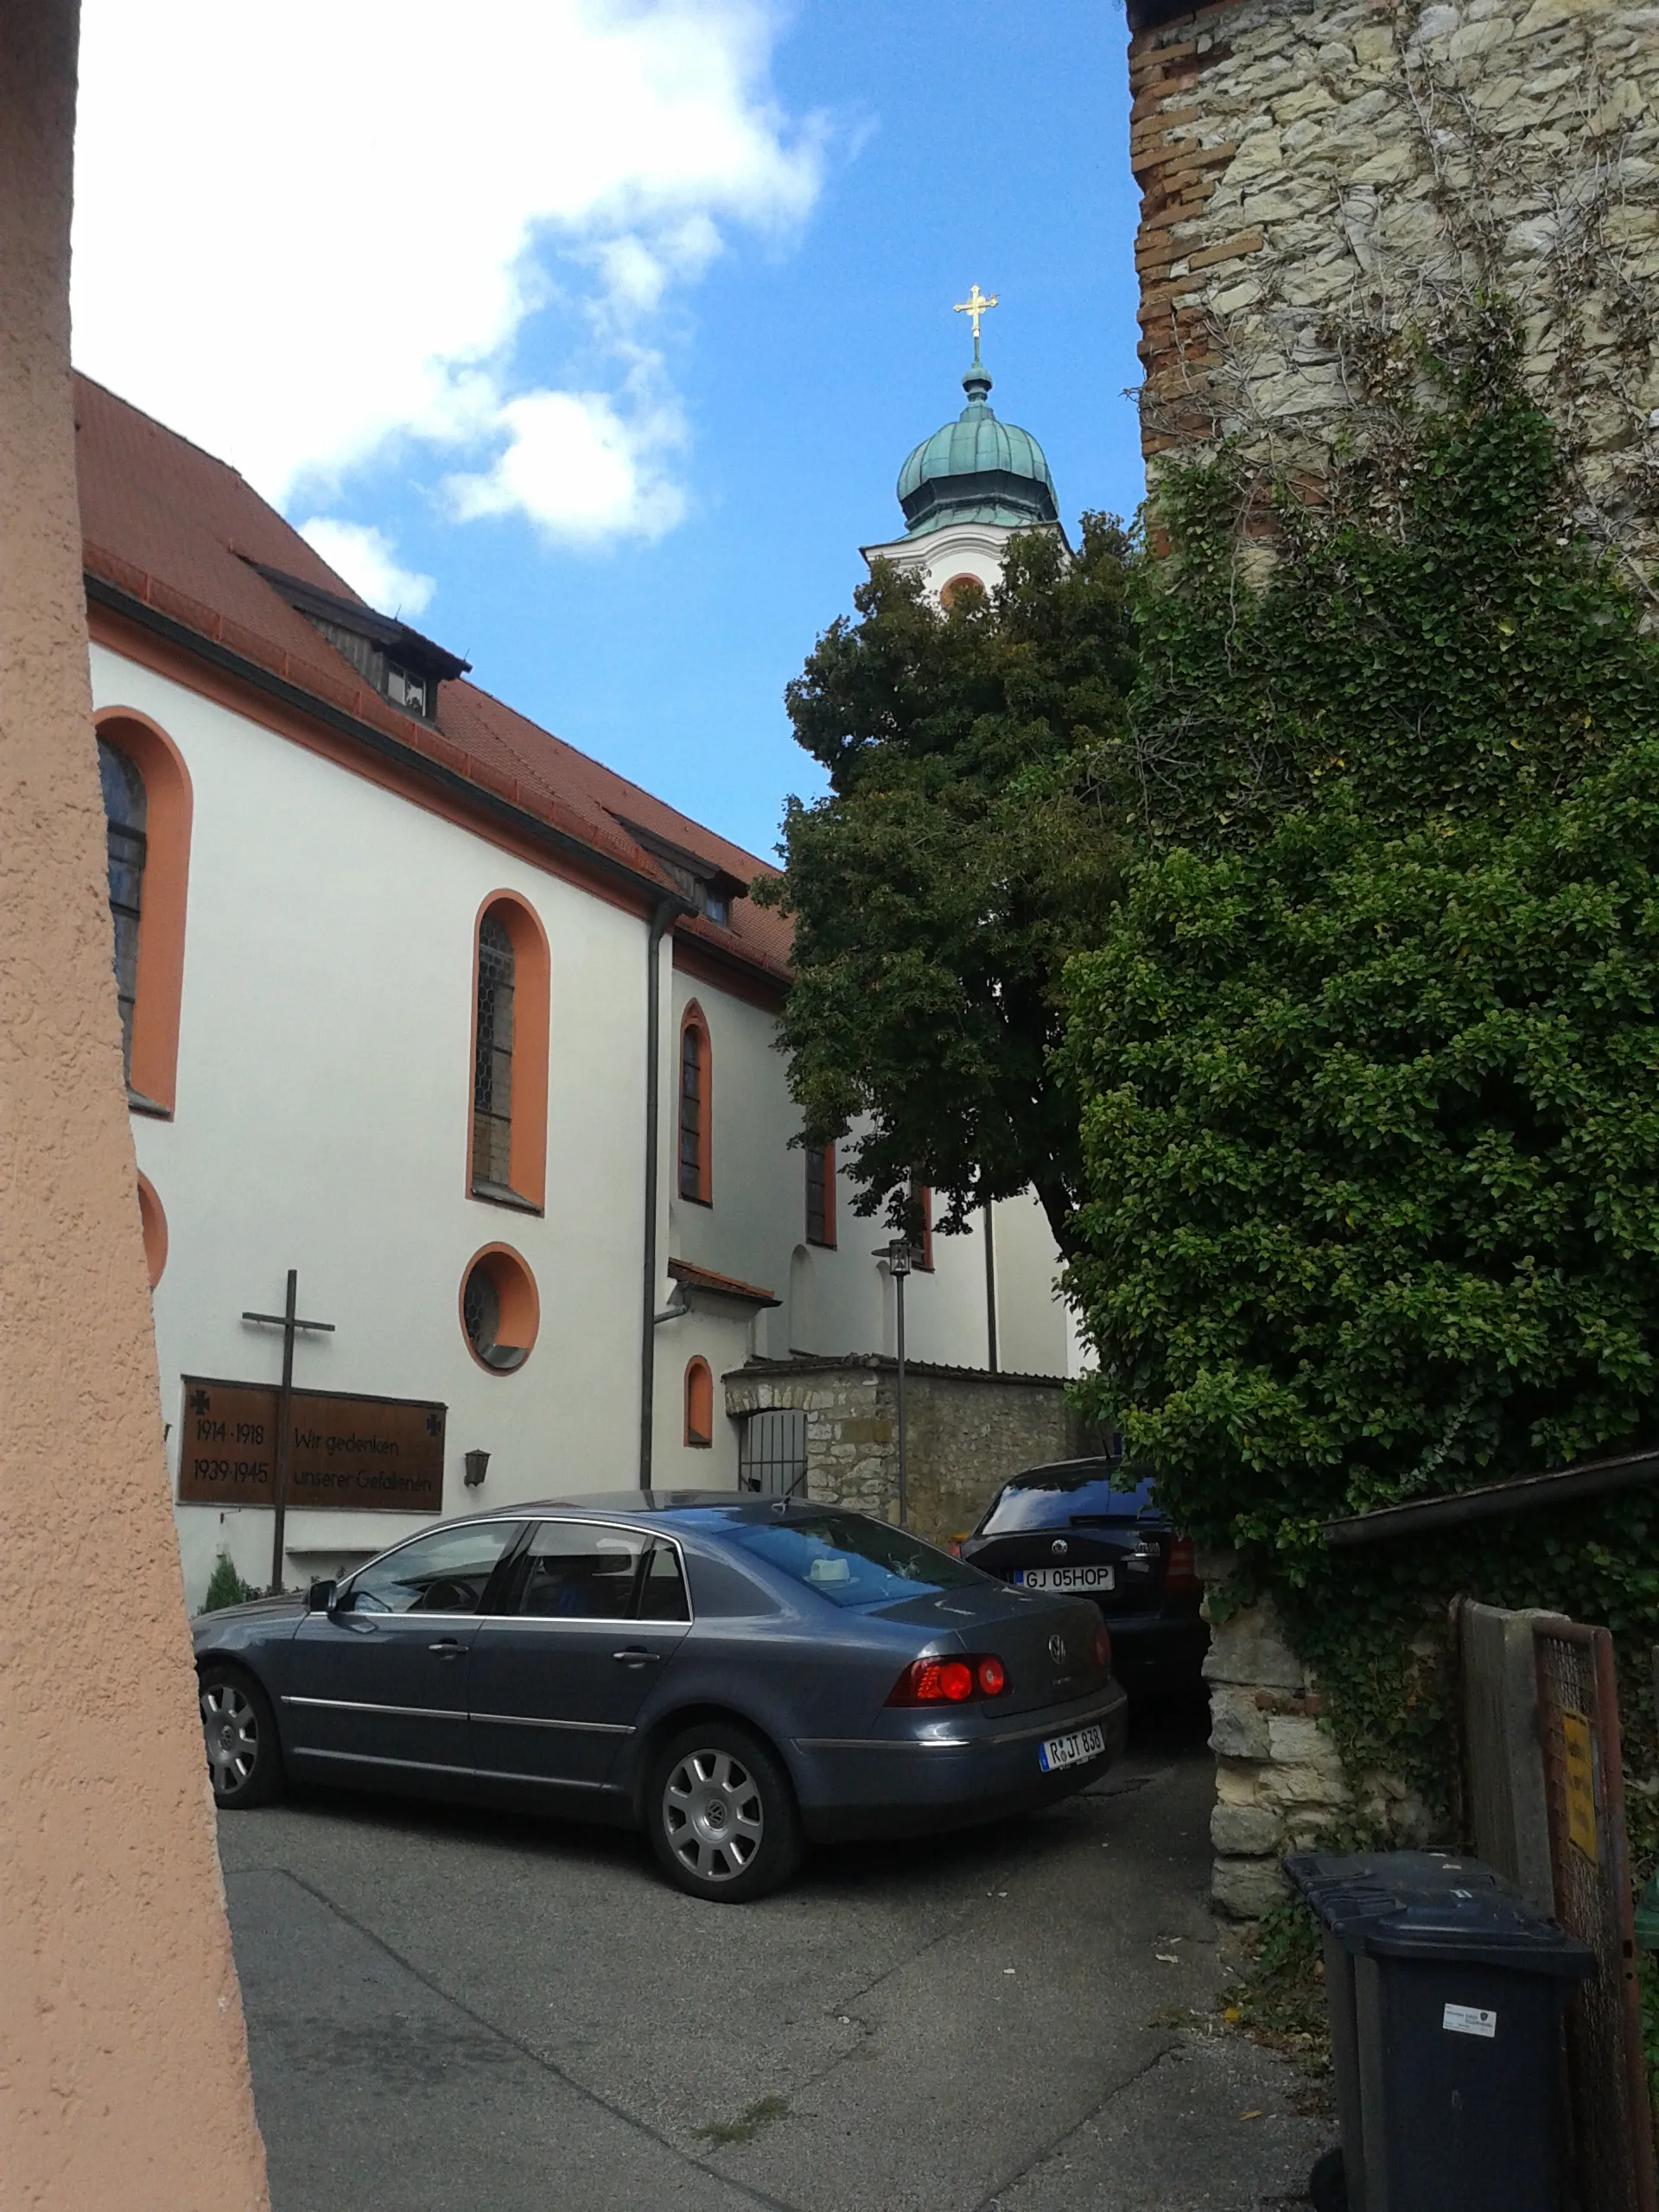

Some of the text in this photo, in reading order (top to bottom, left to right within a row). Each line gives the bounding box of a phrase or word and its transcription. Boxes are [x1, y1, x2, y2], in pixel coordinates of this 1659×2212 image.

[294, 1427, 399, 1457] Wir gedenken
[294, 1468, 431, 1492] unserer Gefallenen
[1027, 1568, 1109, 1588] GJ 05HOP
[1049, 1741, 1060, 1764] R
[1081, 1728, 1101, 1753] 838
